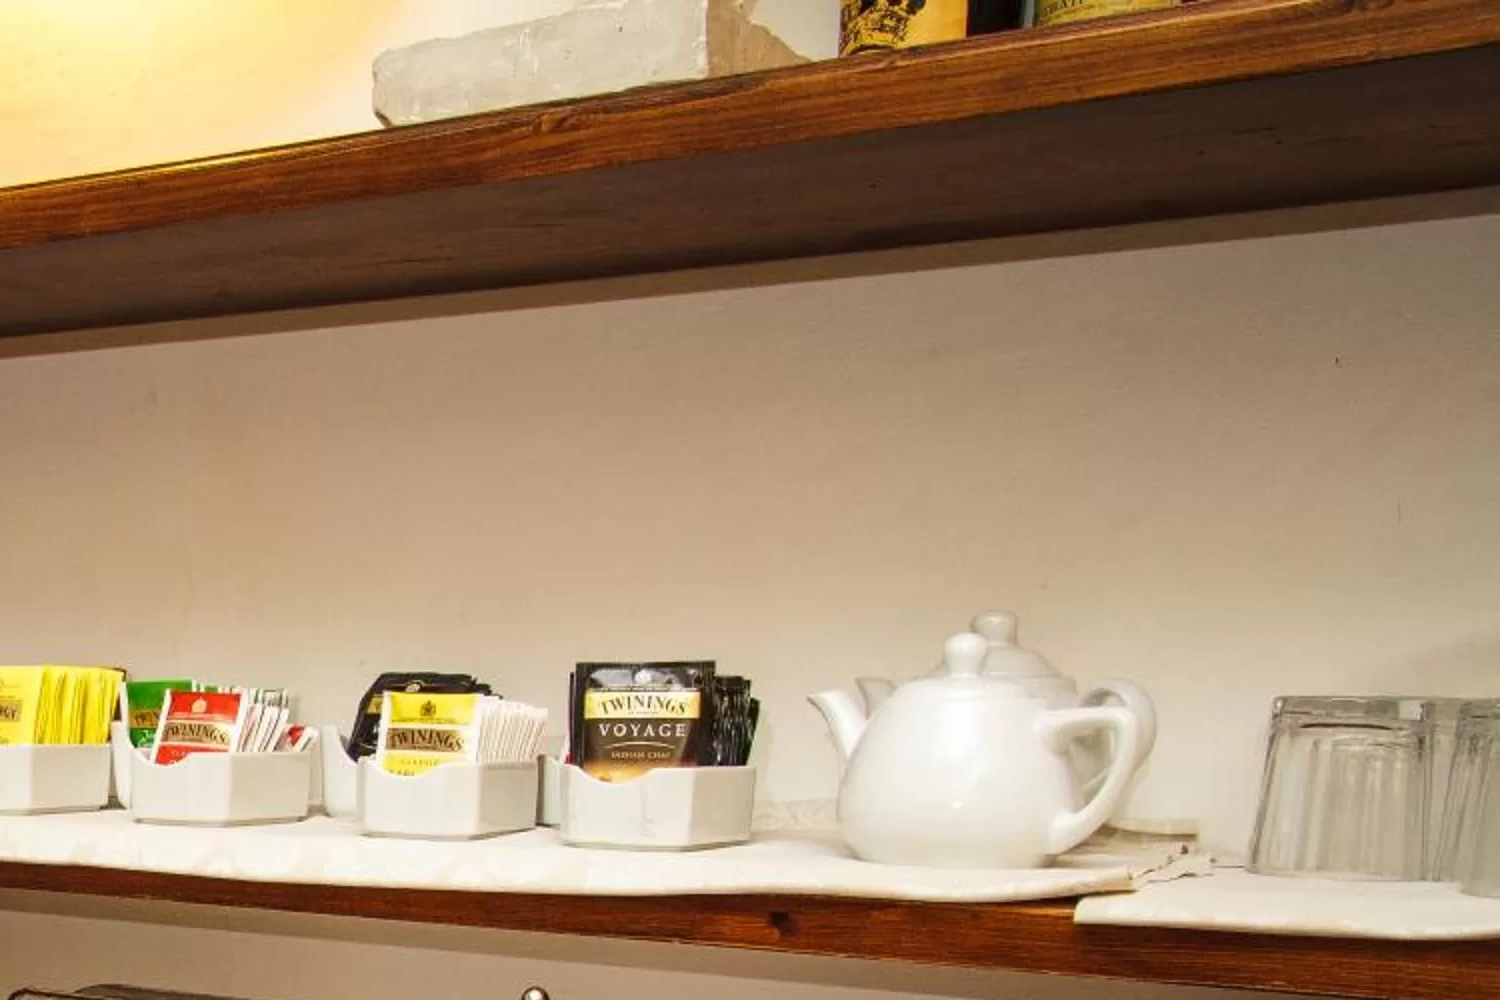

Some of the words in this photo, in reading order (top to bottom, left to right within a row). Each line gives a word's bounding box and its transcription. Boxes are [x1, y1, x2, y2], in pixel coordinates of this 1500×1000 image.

[597, 695, 687, 715] TWININGS
[390, 728, 466, 751] TWININGS
[598, 723, 688, 737] VOYAGE
